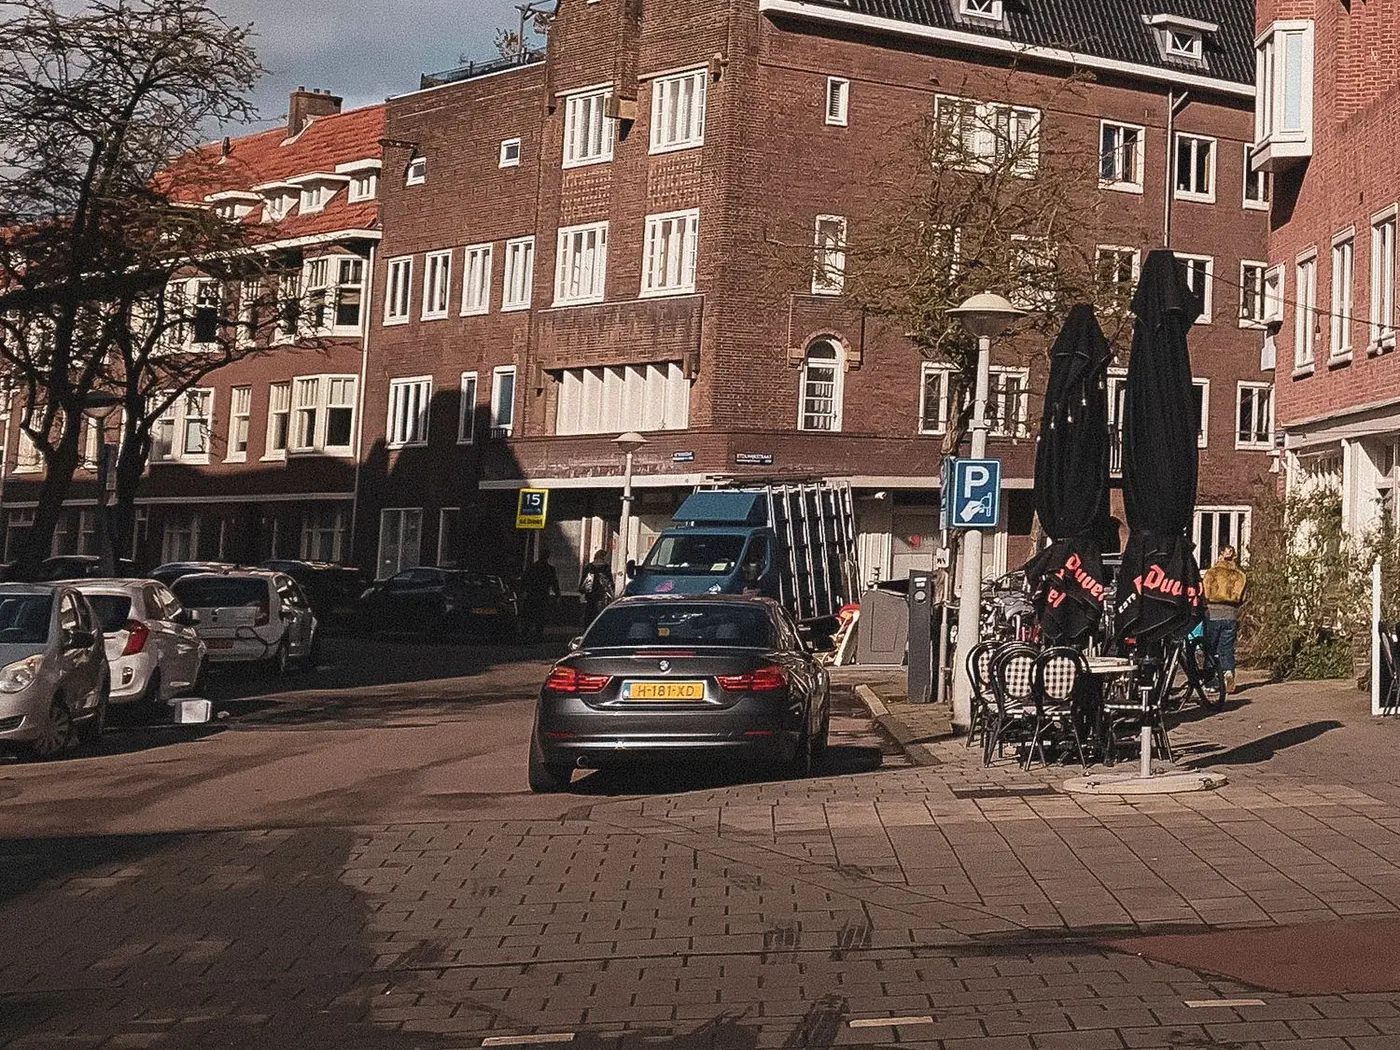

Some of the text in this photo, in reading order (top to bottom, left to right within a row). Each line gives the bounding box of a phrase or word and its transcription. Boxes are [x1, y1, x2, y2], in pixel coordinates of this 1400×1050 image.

[964, 466, 989, 498] P
[526, 493, 541, 506] 15
[637, 685, 695, 697] H-181-XD
